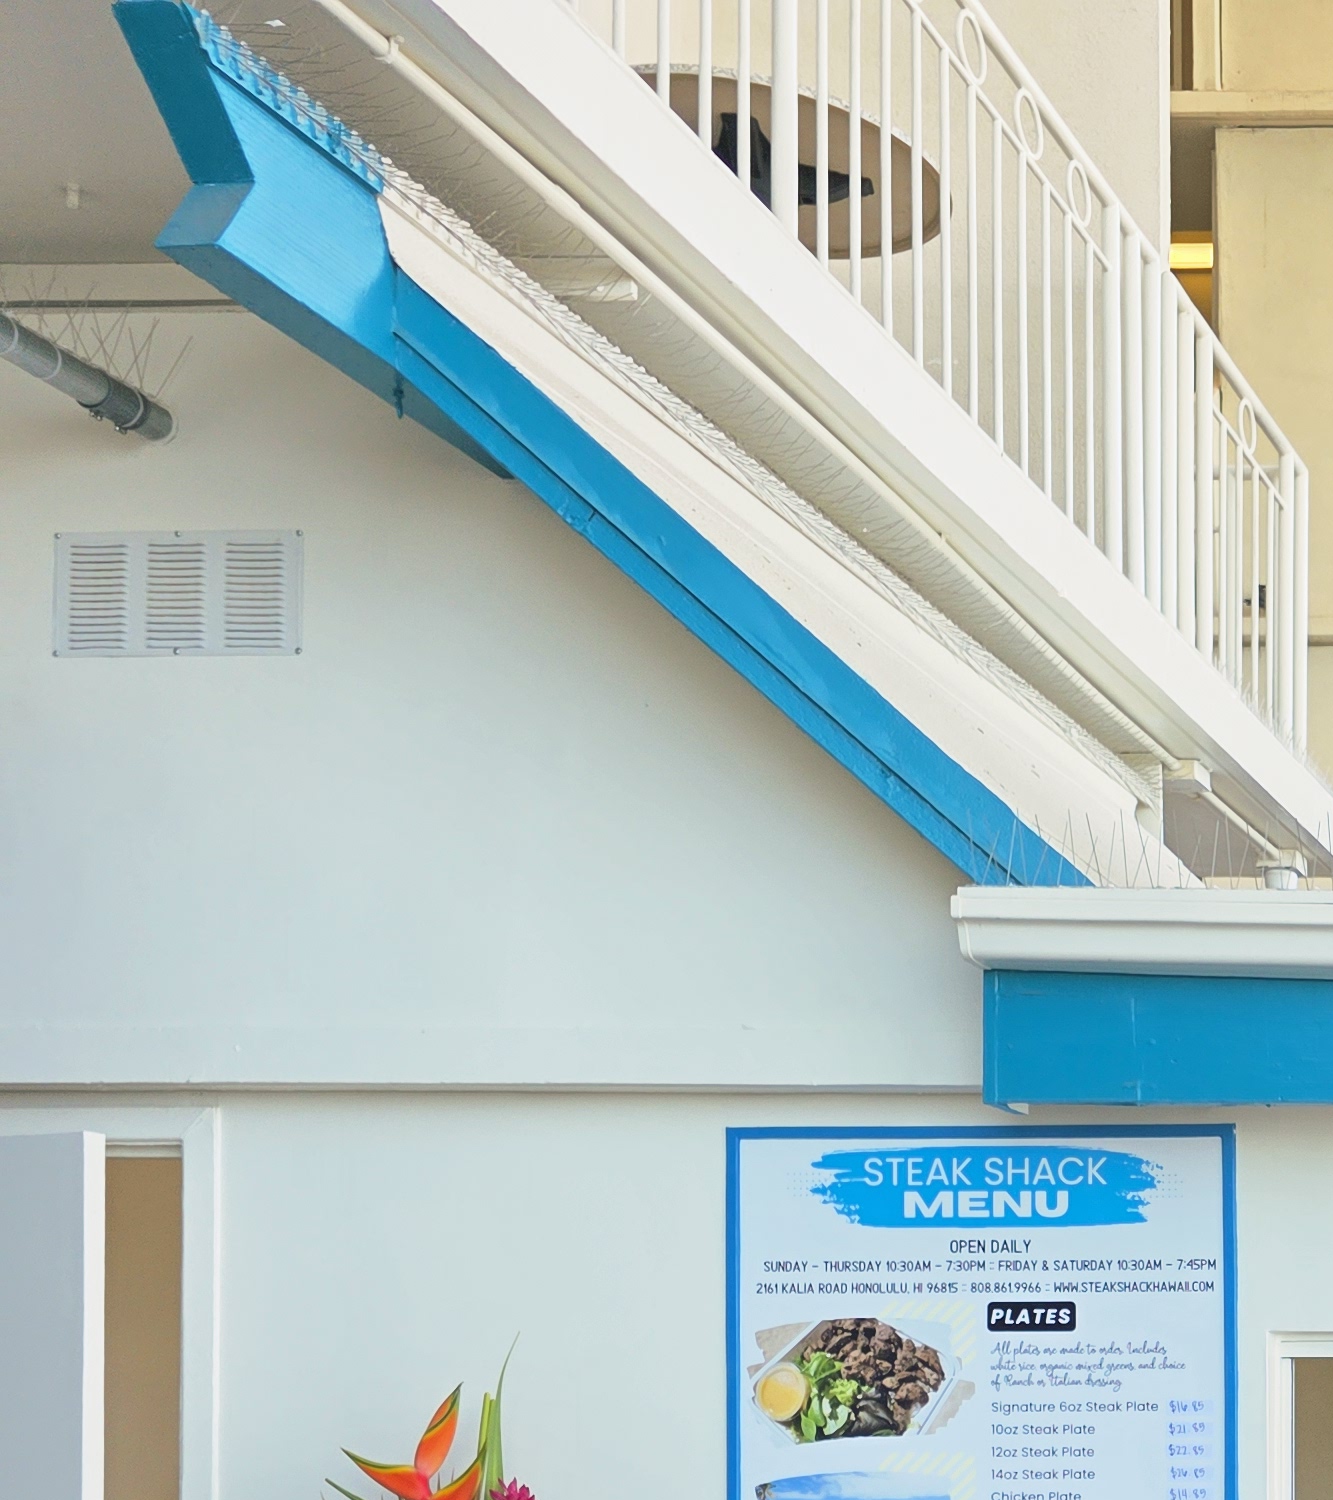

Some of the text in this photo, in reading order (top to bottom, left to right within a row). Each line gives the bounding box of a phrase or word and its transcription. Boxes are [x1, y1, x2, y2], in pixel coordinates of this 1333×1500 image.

[864, 1157, 1108, 1186] STEAK SHACK
[903, 1190, 1069, 1219] MENU
[949, 1240, 1031, 1254] OPEN DAILY
[763, 1259, 1217, 1272] SUNDAY THURSDAY 10:30AM 7:30PM FRIDAY & SATURDAY 10:30AM 7:45PM
[756, 1283, 779, 1294] 2161
[781, 1283, 815, 1294] KALIA
[818, 1282, 848, 1294] ROAD
[913, 1282, 923, 1294] HI
[926, 1282, 958, 1294] 96815
[991, 1309, 1071, 1325] PLATES
[990, 1341, 1011, 1355] All
[1087, 1343, 1096, 1354] to
[1138, 1357, 1156, 1370] and
[1158, 1357, 1186, 1370] choice
[991, 1402, 1159, 1416] Signature 6oz Steak Plate
[991, 1425, 1095, 1435] 10oz Steak Plate
[991, 1447, 1094, 1458] 12oz Steak Plate
[991, 1469, 1095, 1480] 14oz Steak Plate
